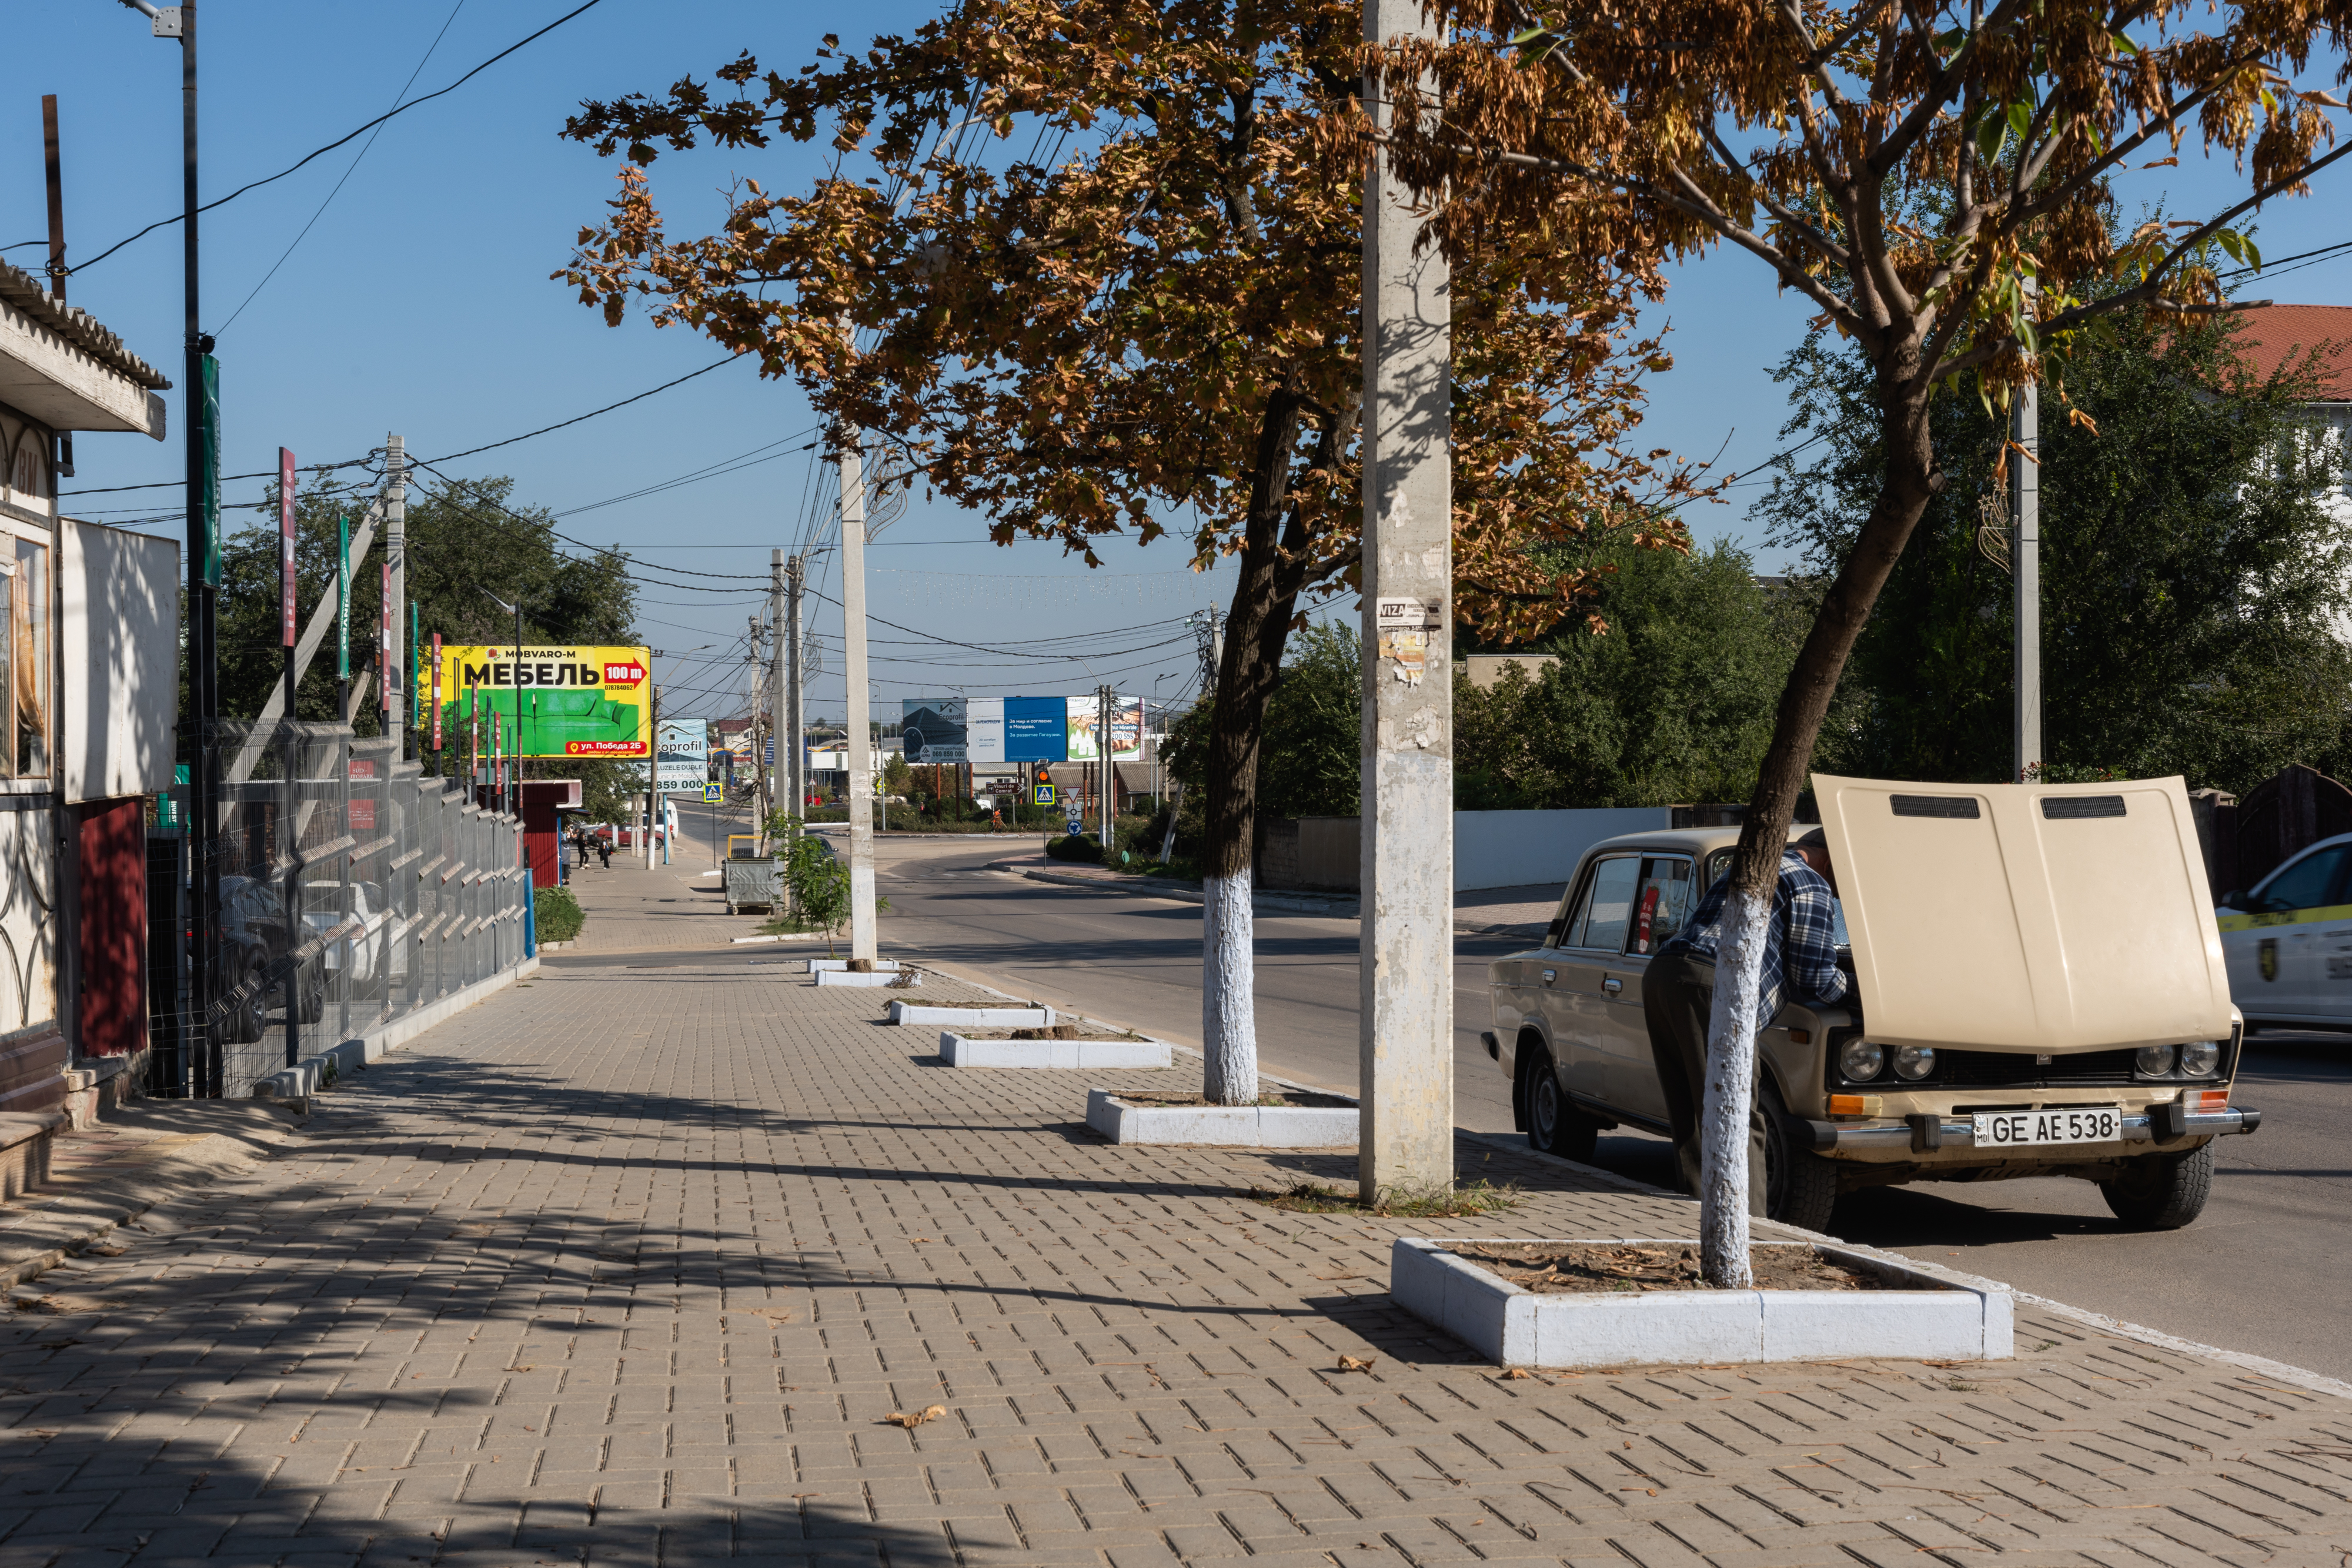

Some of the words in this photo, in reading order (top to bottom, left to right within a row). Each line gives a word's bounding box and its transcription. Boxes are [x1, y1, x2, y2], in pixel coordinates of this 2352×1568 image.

[1380, 605, 1405, 616] VIZA
[465, 663, 600, 686] МЕБЕЛЬ
[606, 666, 629, 679] 100
[938, 713, 964, 721] Ecoprofil
[596, 742, 628, 750] Победа
[657, 781, 677, 789] 859
[681, 780, 703, 788] 000
[1993, 1115, 2029, 1142] GE
[2036, 1115, 2062, 1141] AE
[2069, 1112, 2113, 1139] 538
[1977, 1134, 1987, 1143] MD
